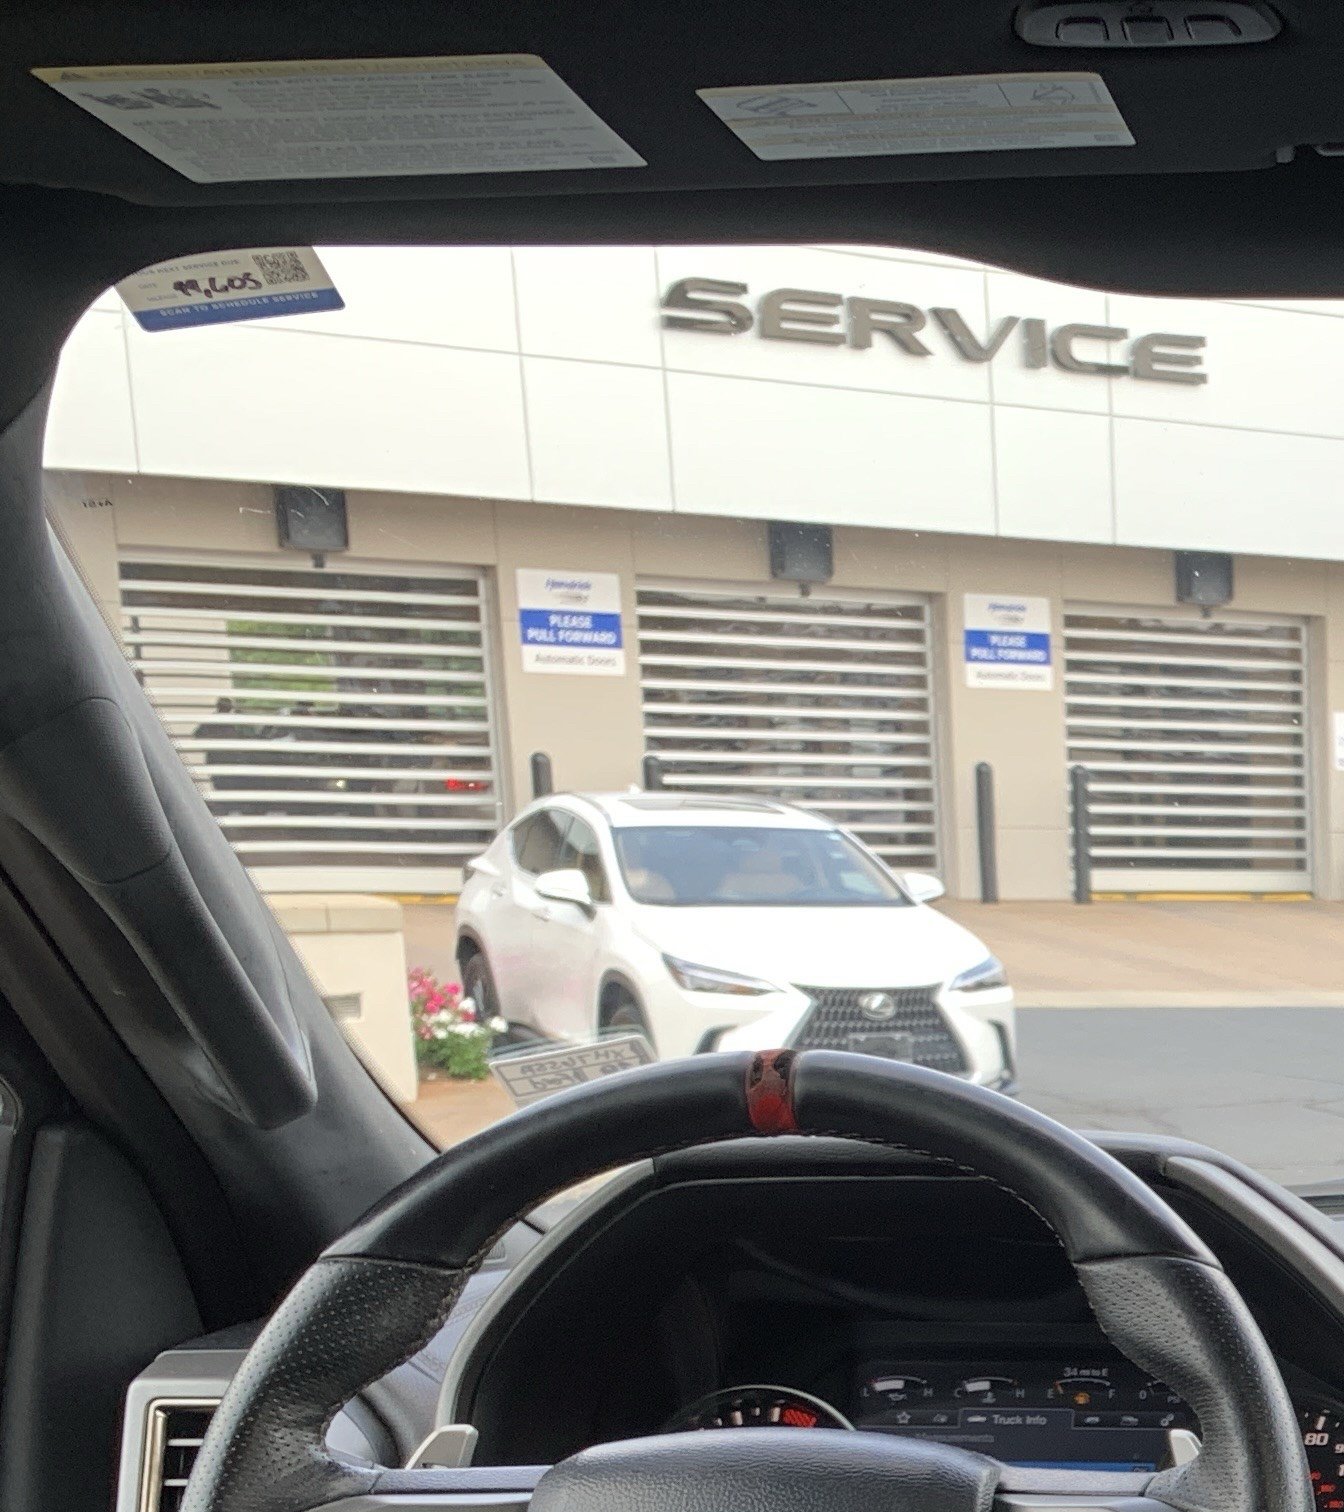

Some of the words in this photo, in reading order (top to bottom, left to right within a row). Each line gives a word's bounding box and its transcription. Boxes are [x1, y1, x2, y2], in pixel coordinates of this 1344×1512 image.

[160, 306, 189, 317] SCAN
[211, 298, 268, 311] SCHEDULE
[273, 291, 319, 304] SERVICE
[659, 276, 1208, 385] SERVICE
[549, 614, 593, 629] PLEASE
[526, 627, 557, 643] PULL
[558, 629, 618, 646] FORWARD
[989, 633, 1028, 648] PLEASE
[993, 1414, 1024, 1426] Truck
[1026, 1414, 1048, 1426] Info
[1304, 1432, 1329, 1446] 80
